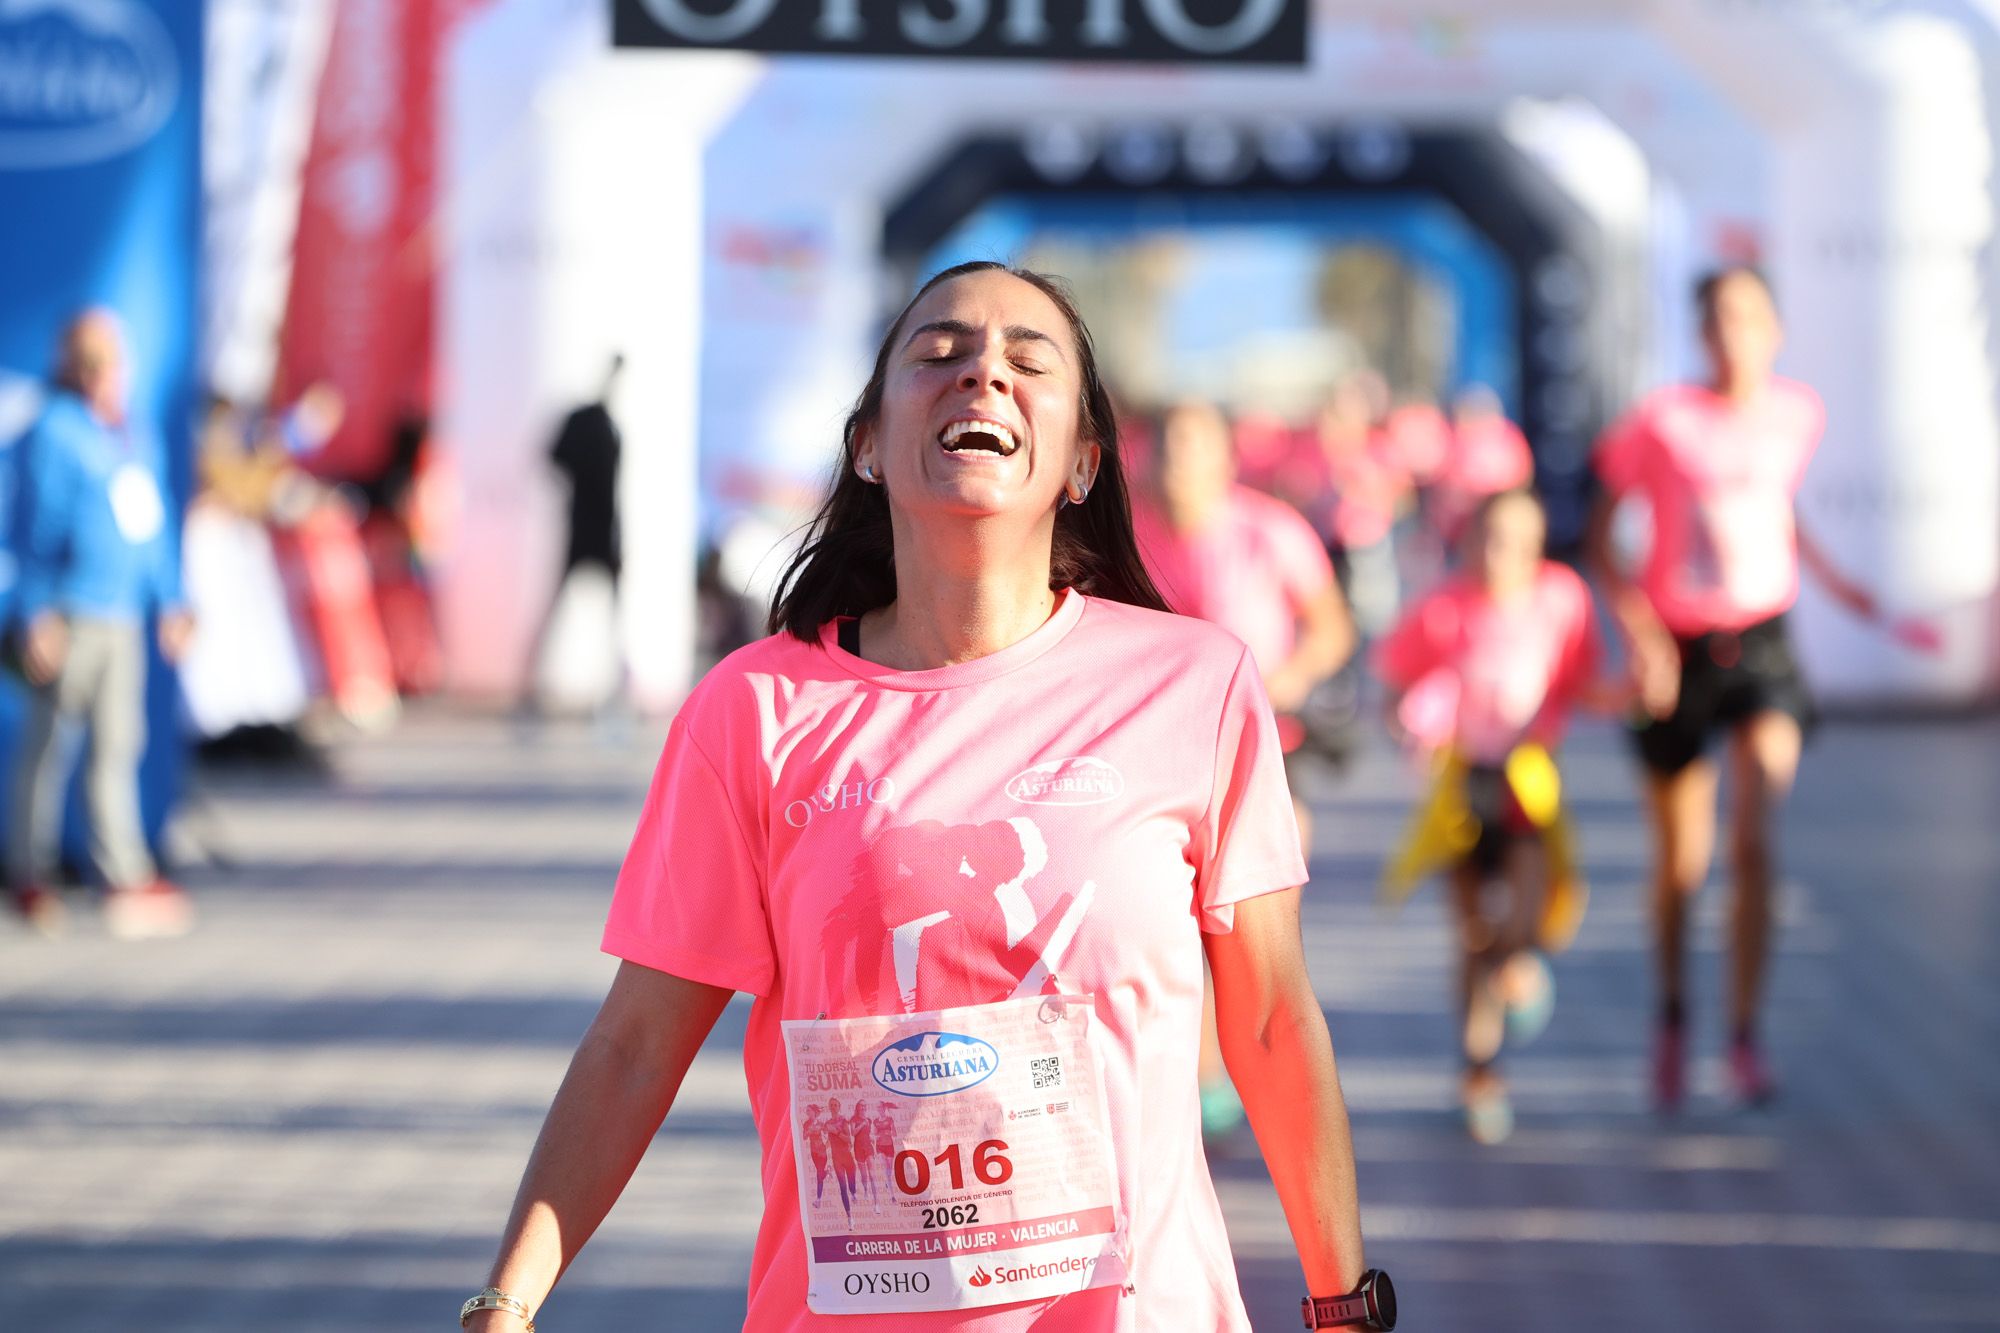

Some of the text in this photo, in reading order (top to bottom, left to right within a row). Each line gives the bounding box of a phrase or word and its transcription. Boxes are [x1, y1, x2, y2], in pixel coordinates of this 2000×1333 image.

[1015, 778, 1116, 797] ASTURIANA
[804, 1060, 860, 1074] TU DORSAL
[882, 1055, 990, 1083] ASTURIANA
[897, 1053, 937, 1063] CENTRAL
[807, 1070, 863, 1092] SUMA
[894, 1139, 1013, 1196] 016
[900, 1199, 934, 1208] TELÉFONO
[935, 1194, 972, 1205] VIOLENCIA
[983, 1189, 1013, 1199] GÉNERO
[921, 1203, 980, 1229] 2062
[845, 1218, 1080, 1256] CARRERA DE LA MUJER VALENCIA
[995, 1256, 1088, 1285] Santander
[844, 1271, 930, 1296] OYSHO
